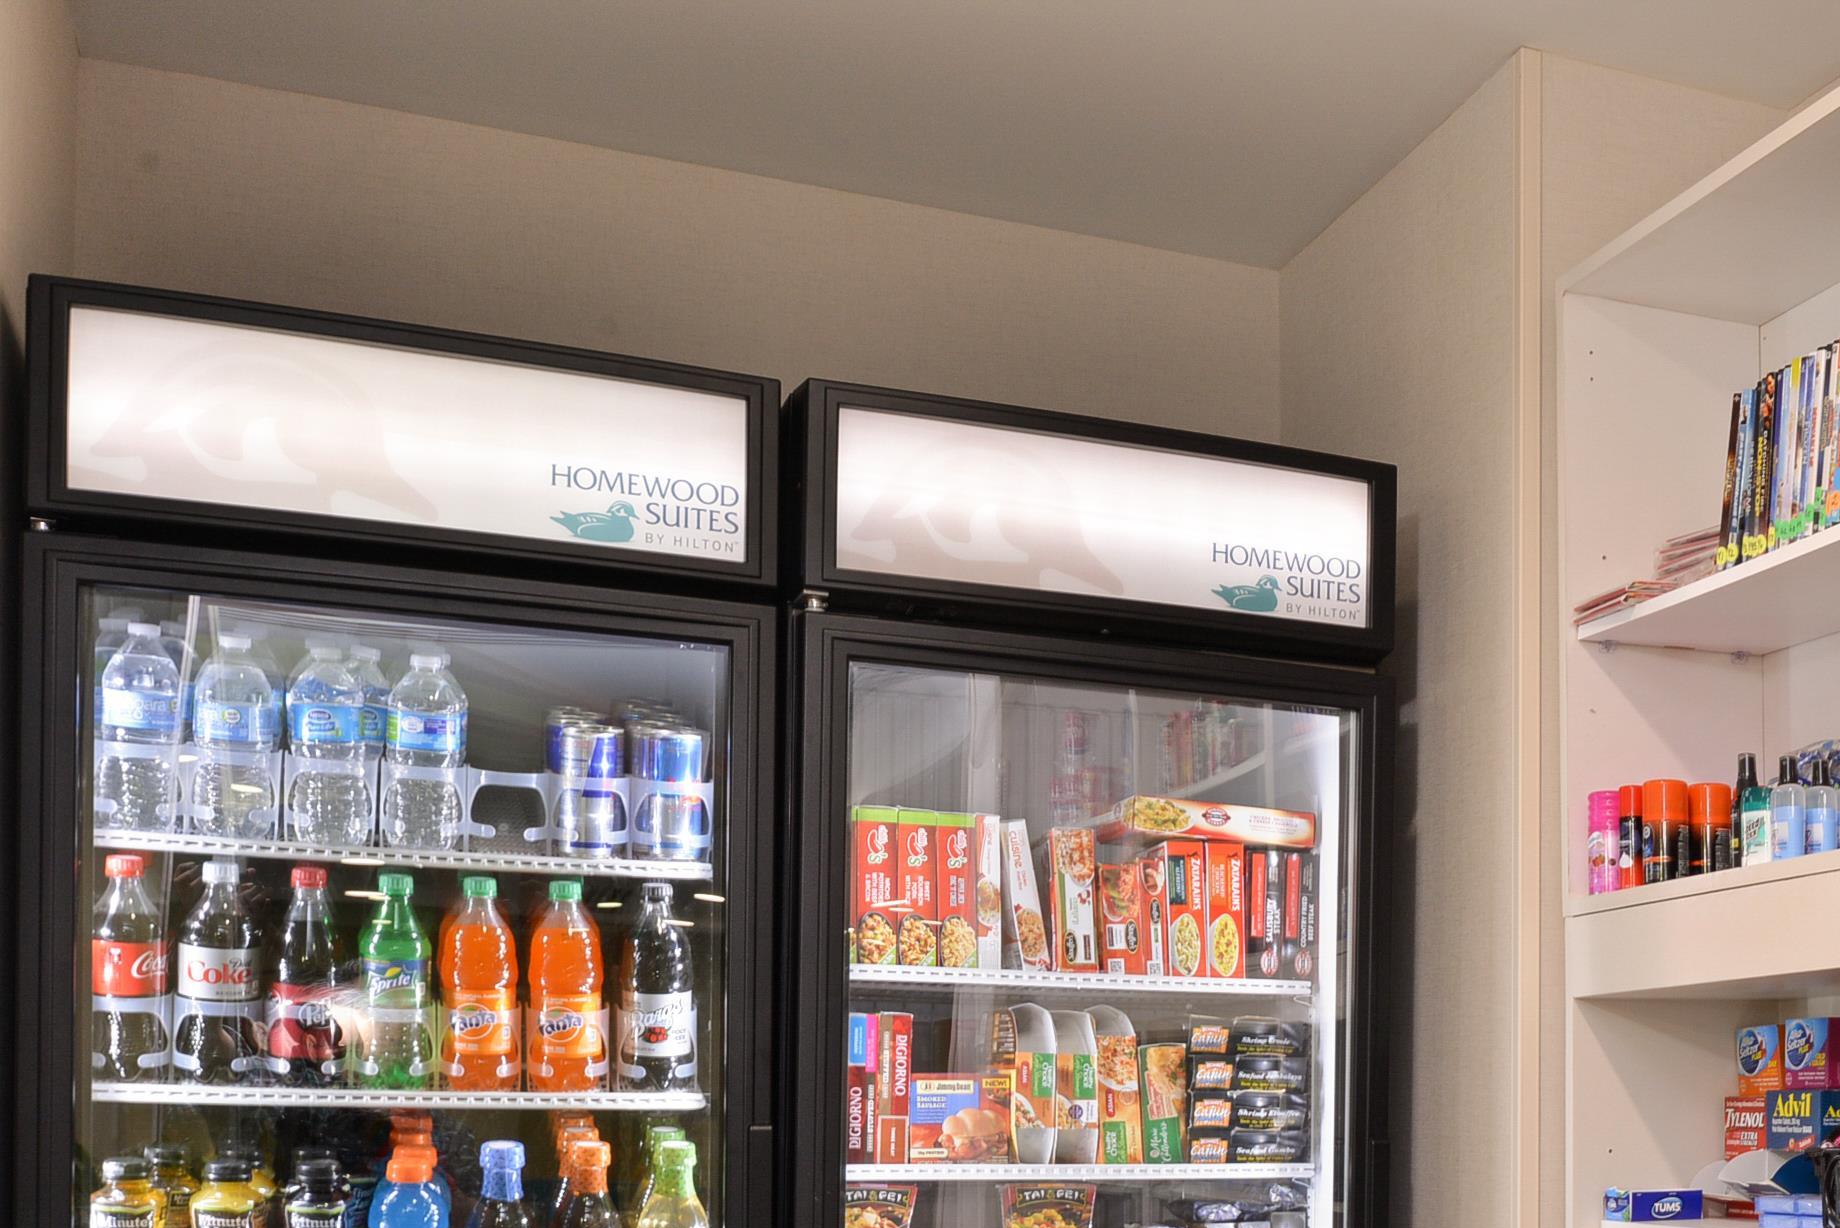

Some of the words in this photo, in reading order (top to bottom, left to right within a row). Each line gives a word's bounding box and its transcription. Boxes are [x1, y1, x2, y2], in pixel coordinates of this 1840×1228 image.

[551, 464, 739, 506] HOMEWOOD
[645, 502, 739, 534] SUITES
[645, 532, 664, 544] BY
[673, 536, 734, 552] HILTON
[1212, 542, 1361, 579] HOMEWOOD
[1287, 576, 1360, 603] SUITES
[1286, 603, 1302, 613] BY
[1308, 606, 1357, 620] HILTON
[188, 961, 251, 985] Coke
[370, 972, 411, 994] Sprite
[895, 1034, 907, 1096] DIGIORNO
[984, 1079, 1007, 1088] NEW!
[1773, 1093, 1811, 1117] Advil
[849, 1087, 862, 1149] DIGIORNO
[1726, 1108, 1764, 1128] TYLENOL
[1741, 1132, 1758, 1140] EXTRA
[1023, 1189, 1045, 1200] TAI
[1055, 1189, 1078, 1200] PEI
[1654, 1202, 1681, 1213] TUMS
[102, 1214, 148, 1228] Minute
